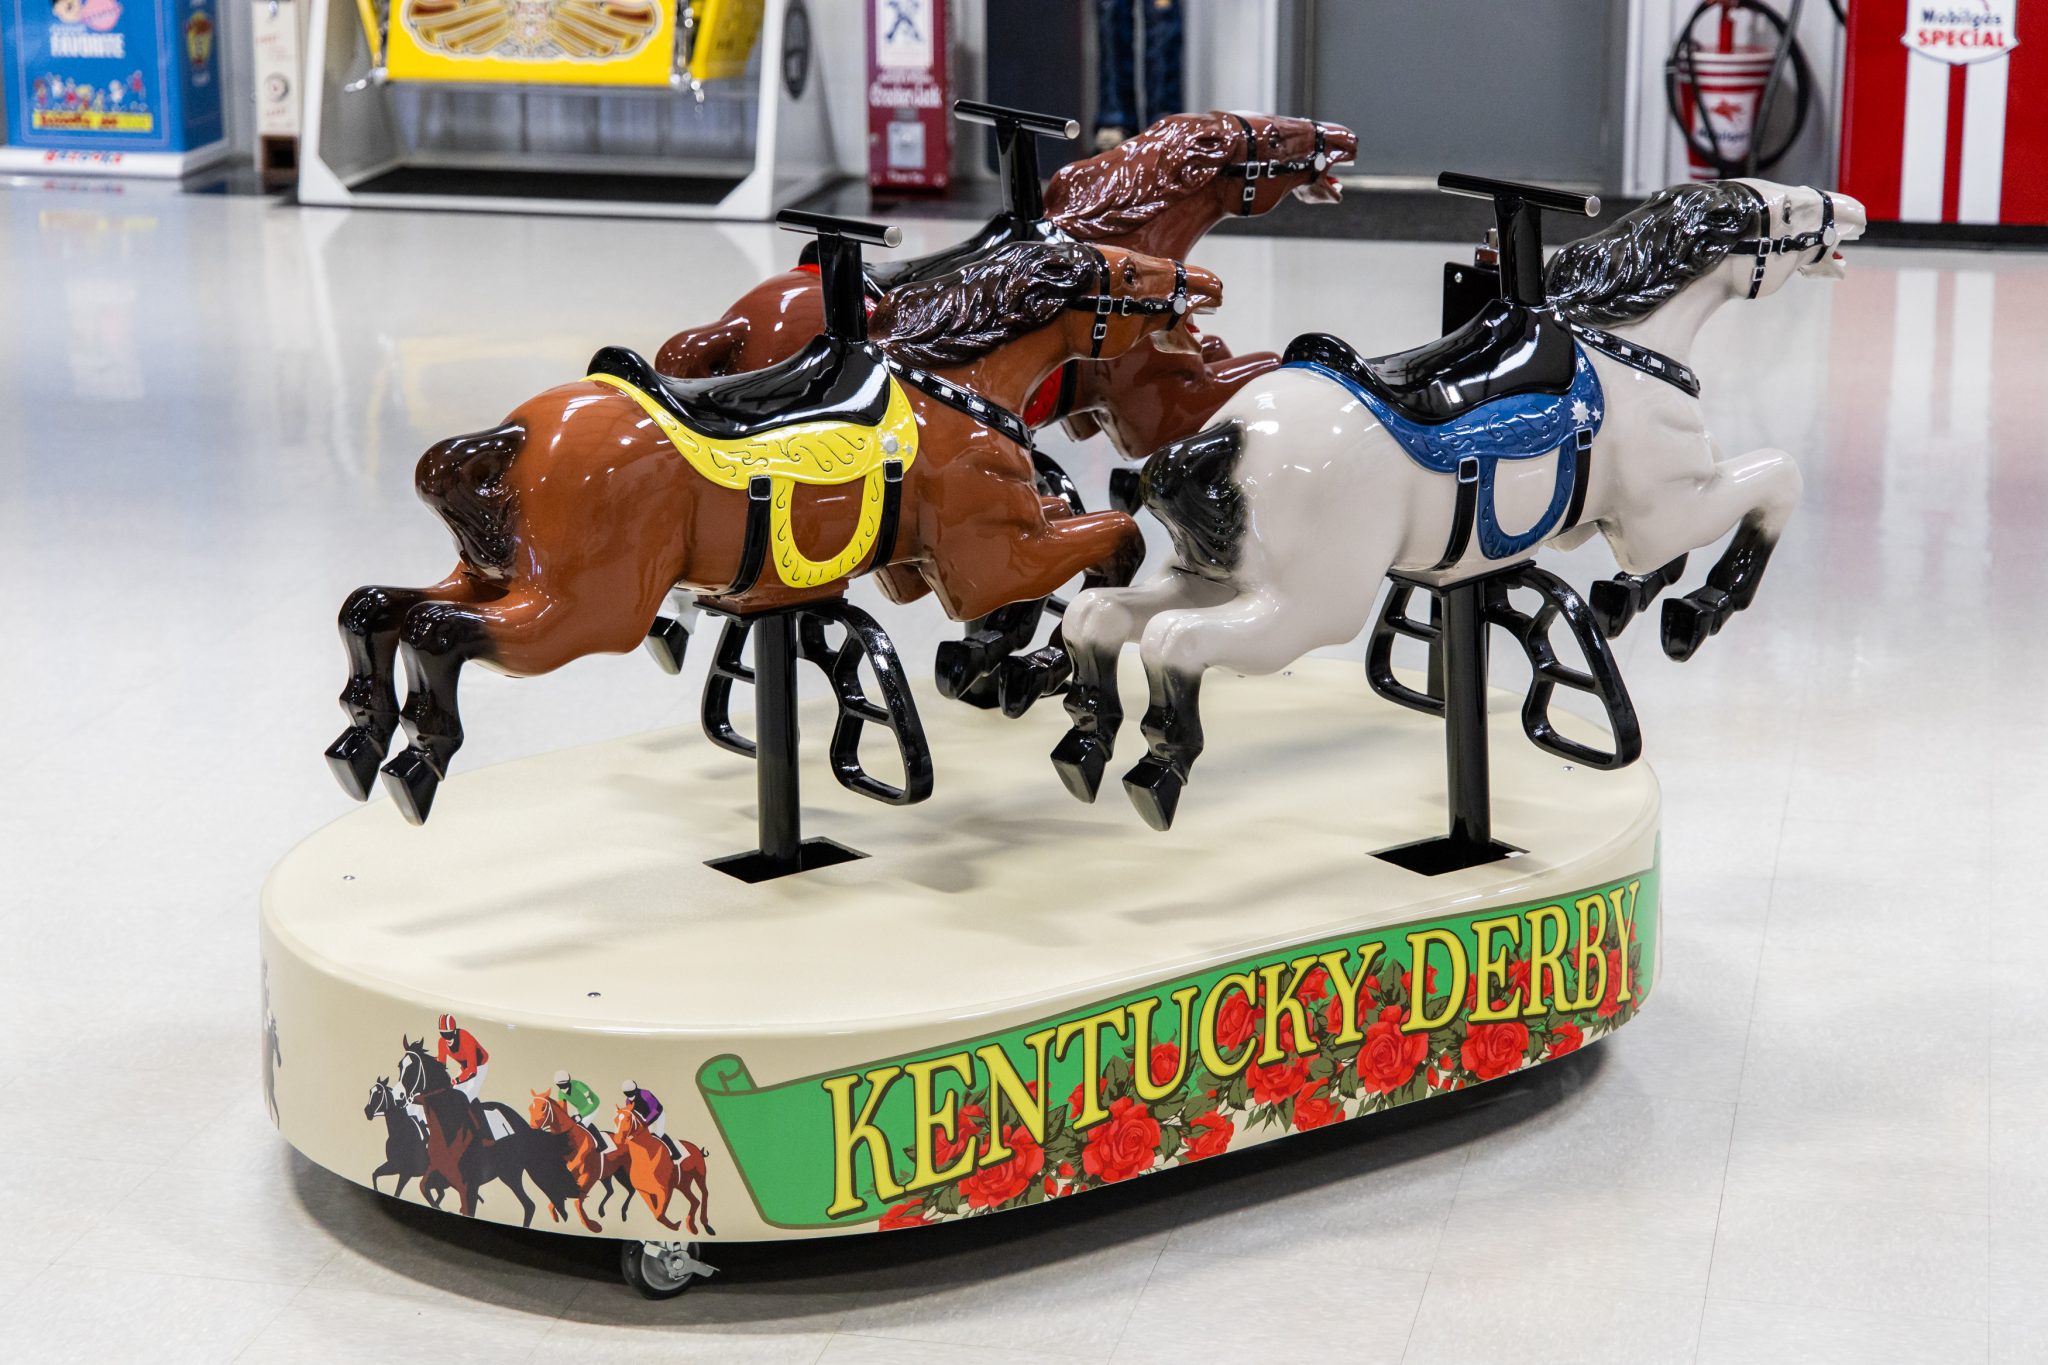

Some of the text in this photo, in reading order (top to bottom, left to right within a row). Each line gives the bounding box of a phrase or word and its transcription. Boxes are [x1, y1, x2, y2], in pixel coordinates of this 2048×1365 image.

[1921, 8, 2003, 29] Mobilgas
[50, 32, 126, 58] FAVORITE
[1918, 29, 2006, 48] SPECIAL
[822, 880, 1640, 1219] KENTUCKY DERBY
